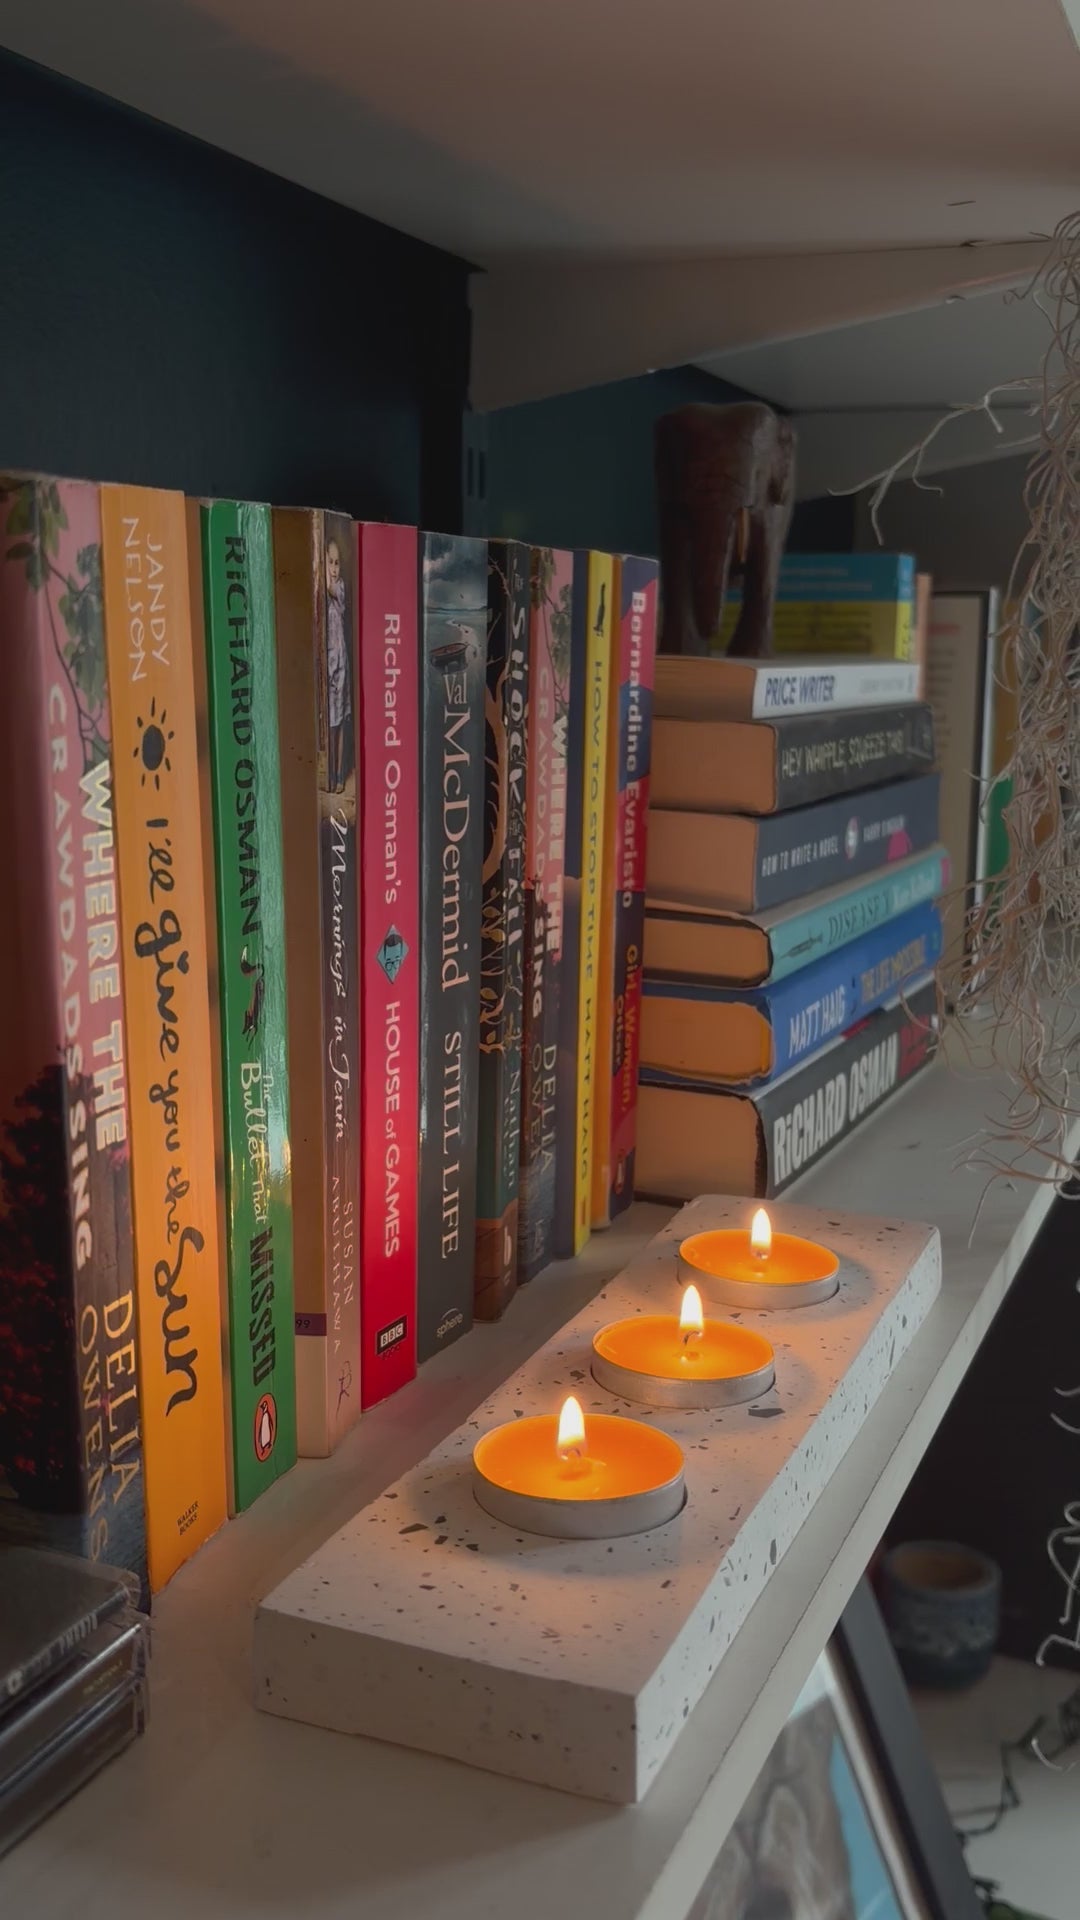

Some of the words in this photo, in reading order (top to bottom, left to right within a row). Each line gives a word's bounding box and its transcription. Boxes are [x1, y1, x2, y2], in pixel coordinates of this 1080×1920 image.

[122, 518, 148, 682] NELSON
[147, 533, 170, 666] JANDY
[384, 613, 401, 747] Richard
[443, 672, 468, 704] Val
[626, 591, 647, 772] Bernardine
[765, 678, 797, 706] PRICE
[799, 675, 835, 704] WRITER
[535, 668, 549, 902] CRAWDADS
[549, 716, 568, 860] WHERE
[590, 756, 600, 800] TO
[781, 749, 801, 778] HEY
[79, 759, 119, 1003] WHERE
[233, 757, 262, 936] OSMAN
[384, 759, 403, 904] Osman's
[442, 705, 471, 992] McDermid
[622, 781, 640, 908] Evaristo
[762, 857, 777, 877] HOW
[780, 853, 788, 871] TO
[791, 844, 811, 867] WRITE
[329, 808, 348, 998] Mornings
[547, 874, 563, 952] THE
[47, 683, 82, 1081] CRAWDADS
[68, 1100, 93, 1272] SING
[533, 919, 544, 1018] SING
[788, 1001, 820, 1059] MATT
[820, 983, 846, 1036] HAIG
[91, 1020, 125, 1153] THE
[334, 1014, 347, 1045] in
[385, 1001, 400, 1114] HOUSE
[849, 1032, 899, 1122] OSMAN
[240, 1060, 270, 1168] Bullet
[385, 1119, 395, 1141] of
[443, 1031, 462, 1154] STILL
[541, 1045, 556, 1174] DELIA
[149, 1070, 181, 1151] you
[165, 1166, 190, 1244] the
[253, 1174, 269, 1225] That
[384, 1144, 400, 1259] GAMES
[441, 1162, 460, 1259] LIFE
[249, 1225, 276, 1387] MISSED
[343, 1200, 354, 1305] SUSAN
[380, 1322, 404, 1348] BBC
[436, 1311, 464, 1339] sphere
[80, 1304, 108, 1562] OWENS
[103, 1289, 143, 1504] DELIA
[176, 1501, 200, 1528] WALKER
[179, 1513, 200, 1536] BOOKS
